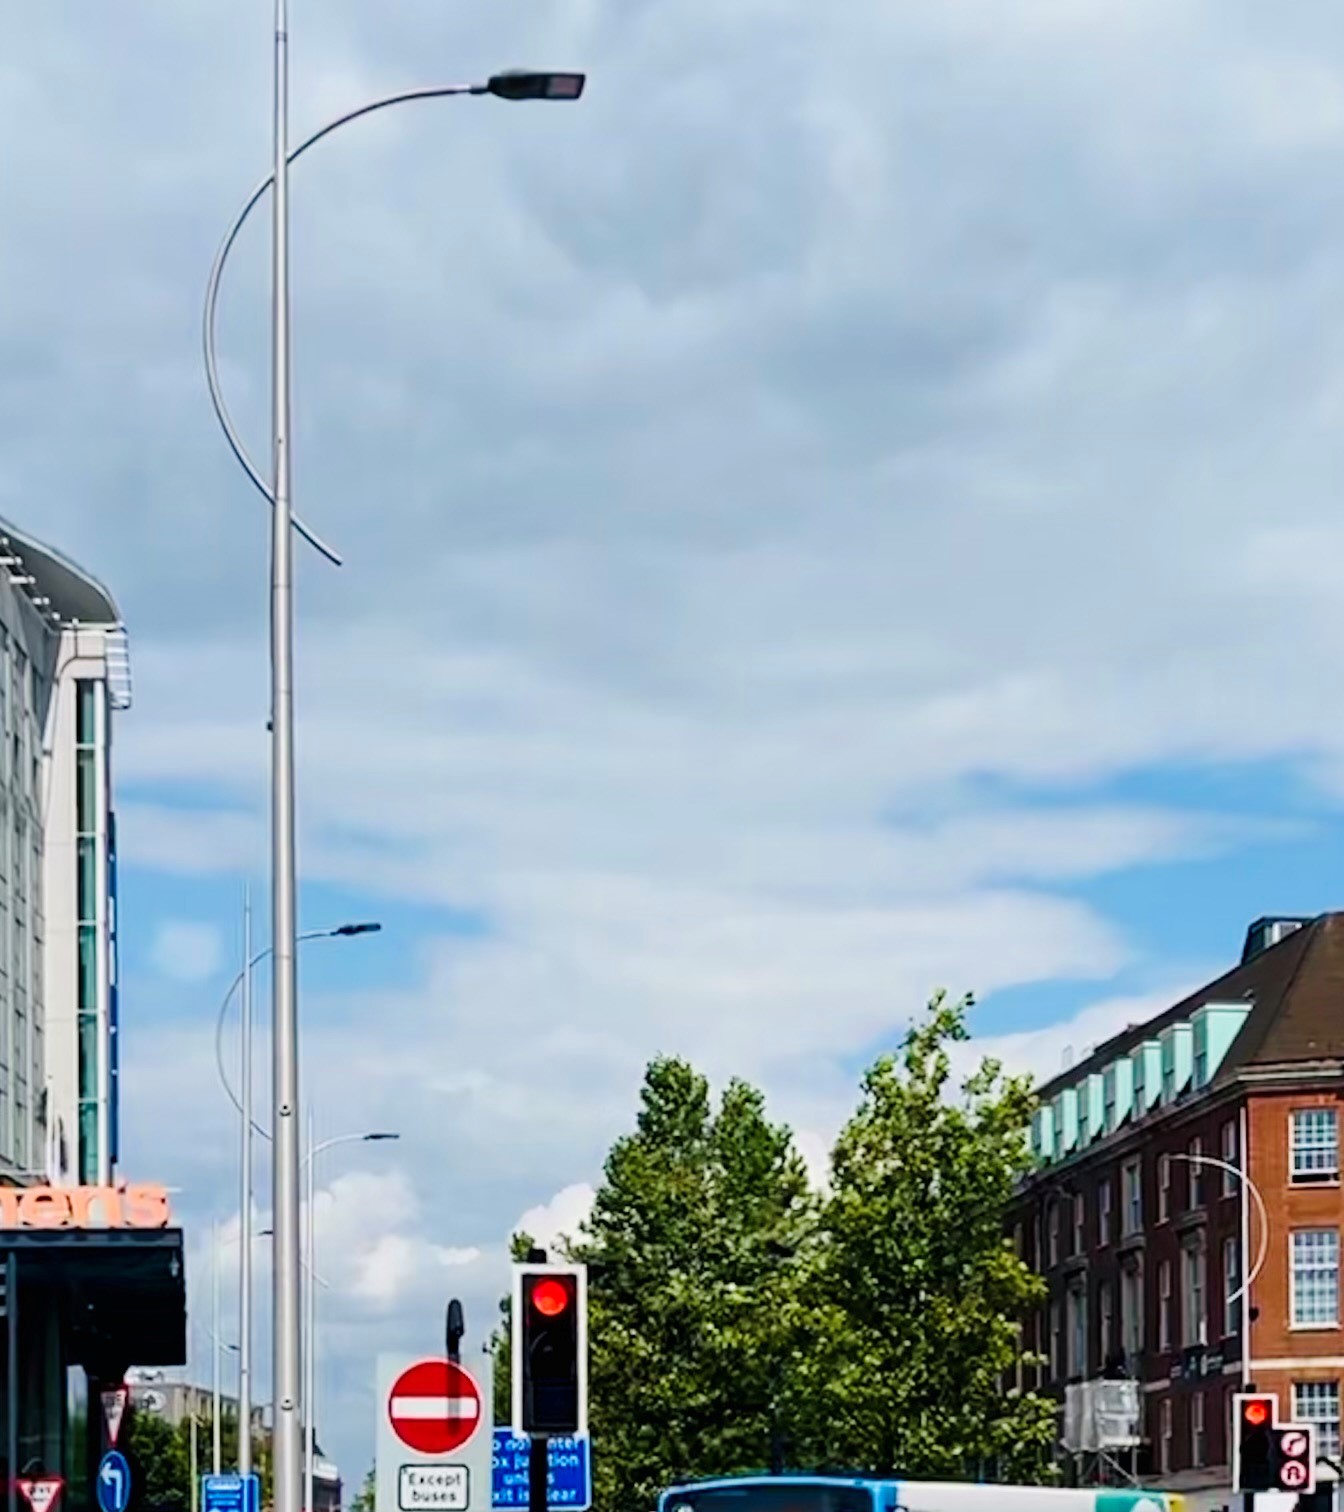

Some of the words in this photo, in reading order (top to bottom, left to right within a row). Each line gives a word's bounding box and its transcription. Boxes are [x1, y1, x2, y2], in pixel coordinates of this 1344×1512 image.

[514, 1452, 579, 1470] jution
[408, 1472, 461, 1487] Except
[412, 1489, 457, 1502] buses
